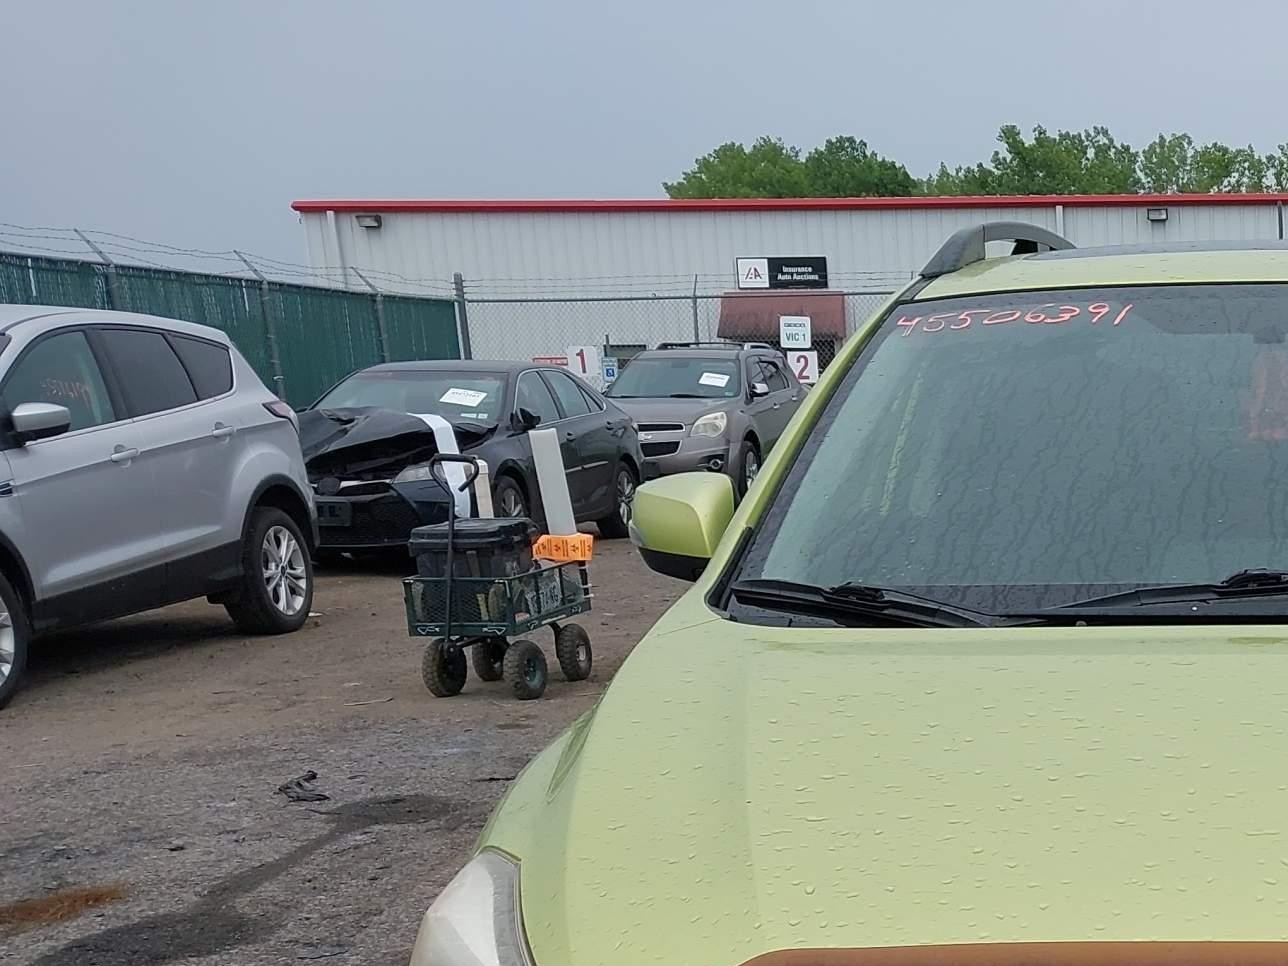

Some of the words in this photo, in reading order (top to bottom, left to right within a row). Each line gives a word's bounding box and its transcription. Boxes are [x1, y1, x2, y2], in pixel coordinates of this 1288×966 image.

[897, 303, 1133, 336] 45506391
[785, 332, 800, 341] VIC
[801, 333, 806, 342] 1
[576, 348, 587, 374] 1
[796, 354, 810, 380] 2
